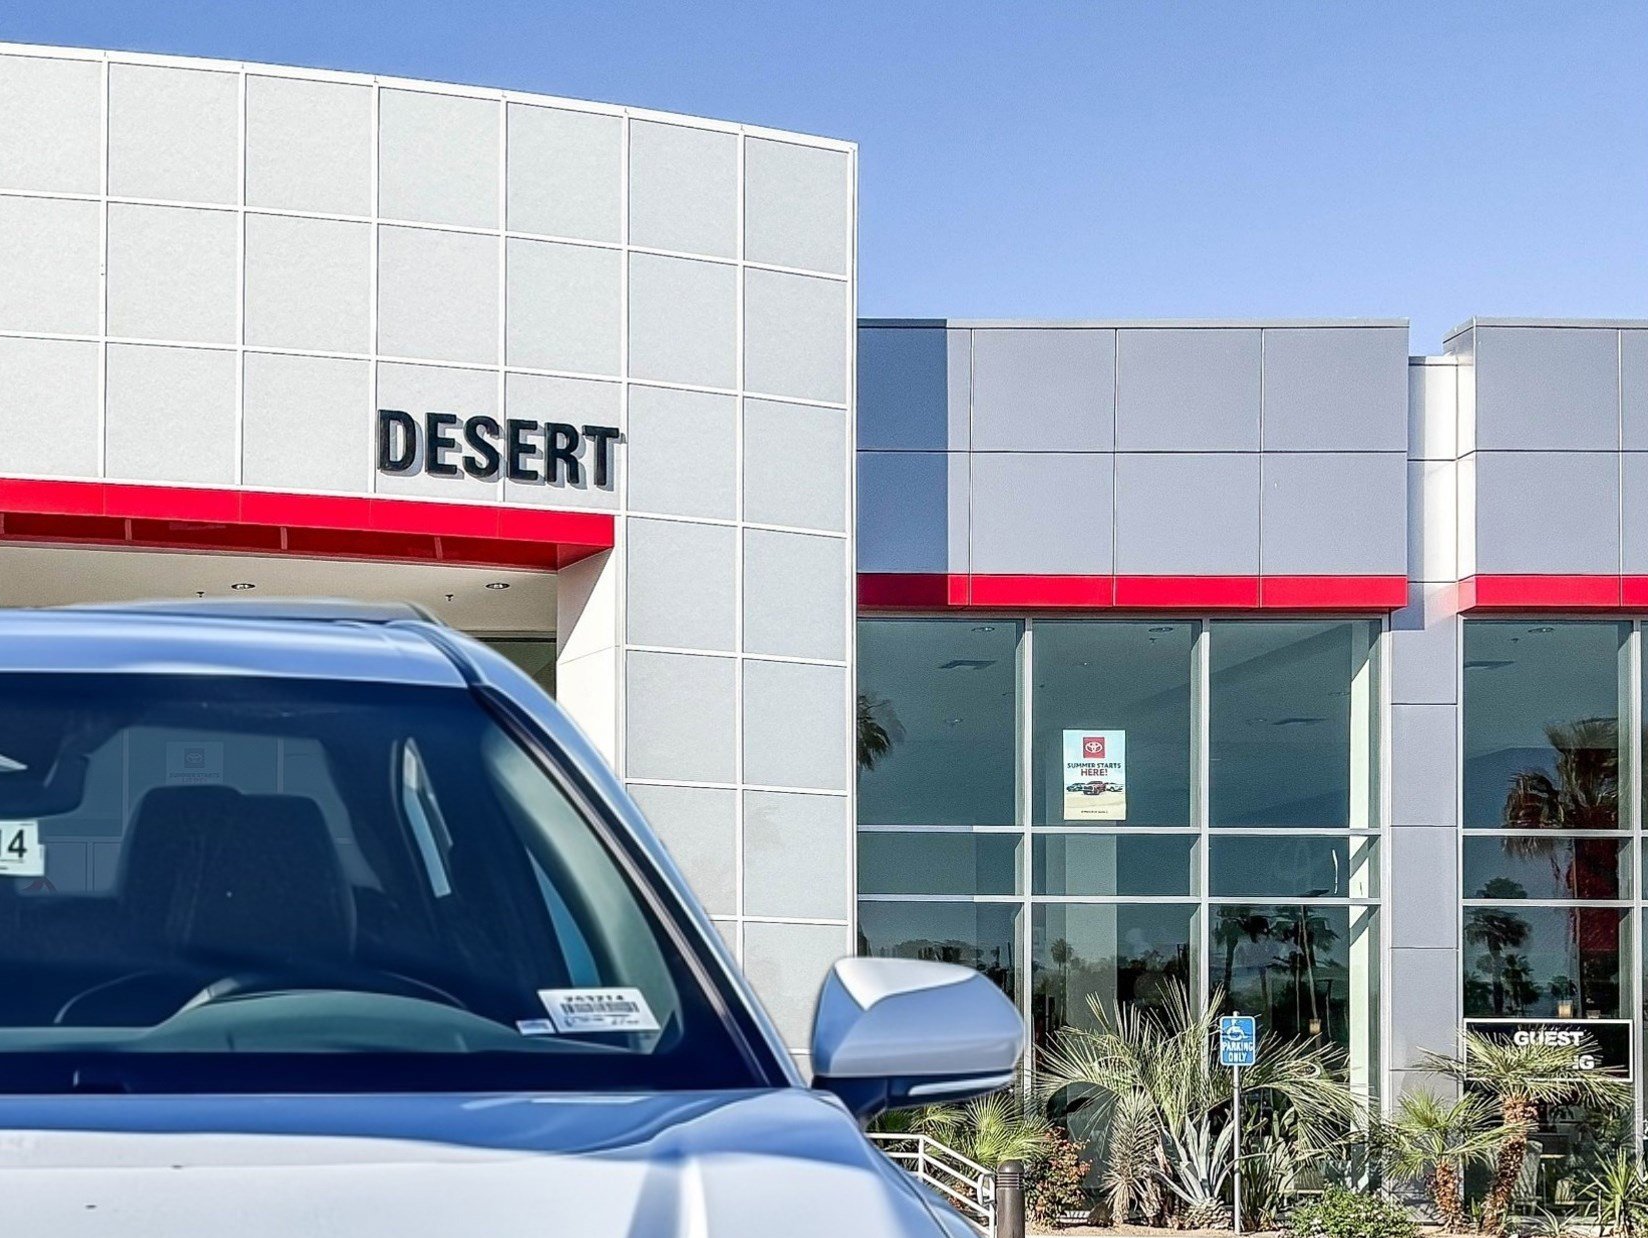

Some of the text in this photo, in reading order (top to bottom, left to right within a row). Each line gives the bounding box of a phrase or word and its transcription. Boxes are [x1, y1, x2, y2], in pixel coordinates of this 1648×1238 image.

[377, 409, 620, 486] DESERT
[1080, 768, 1108, 777] HERE!
[1513, 1031, 1584, 1047] GUEST
[1222, 1041, 1254, 1052] PARKING
[1228, 1052, 1248, 1063] ONLY
